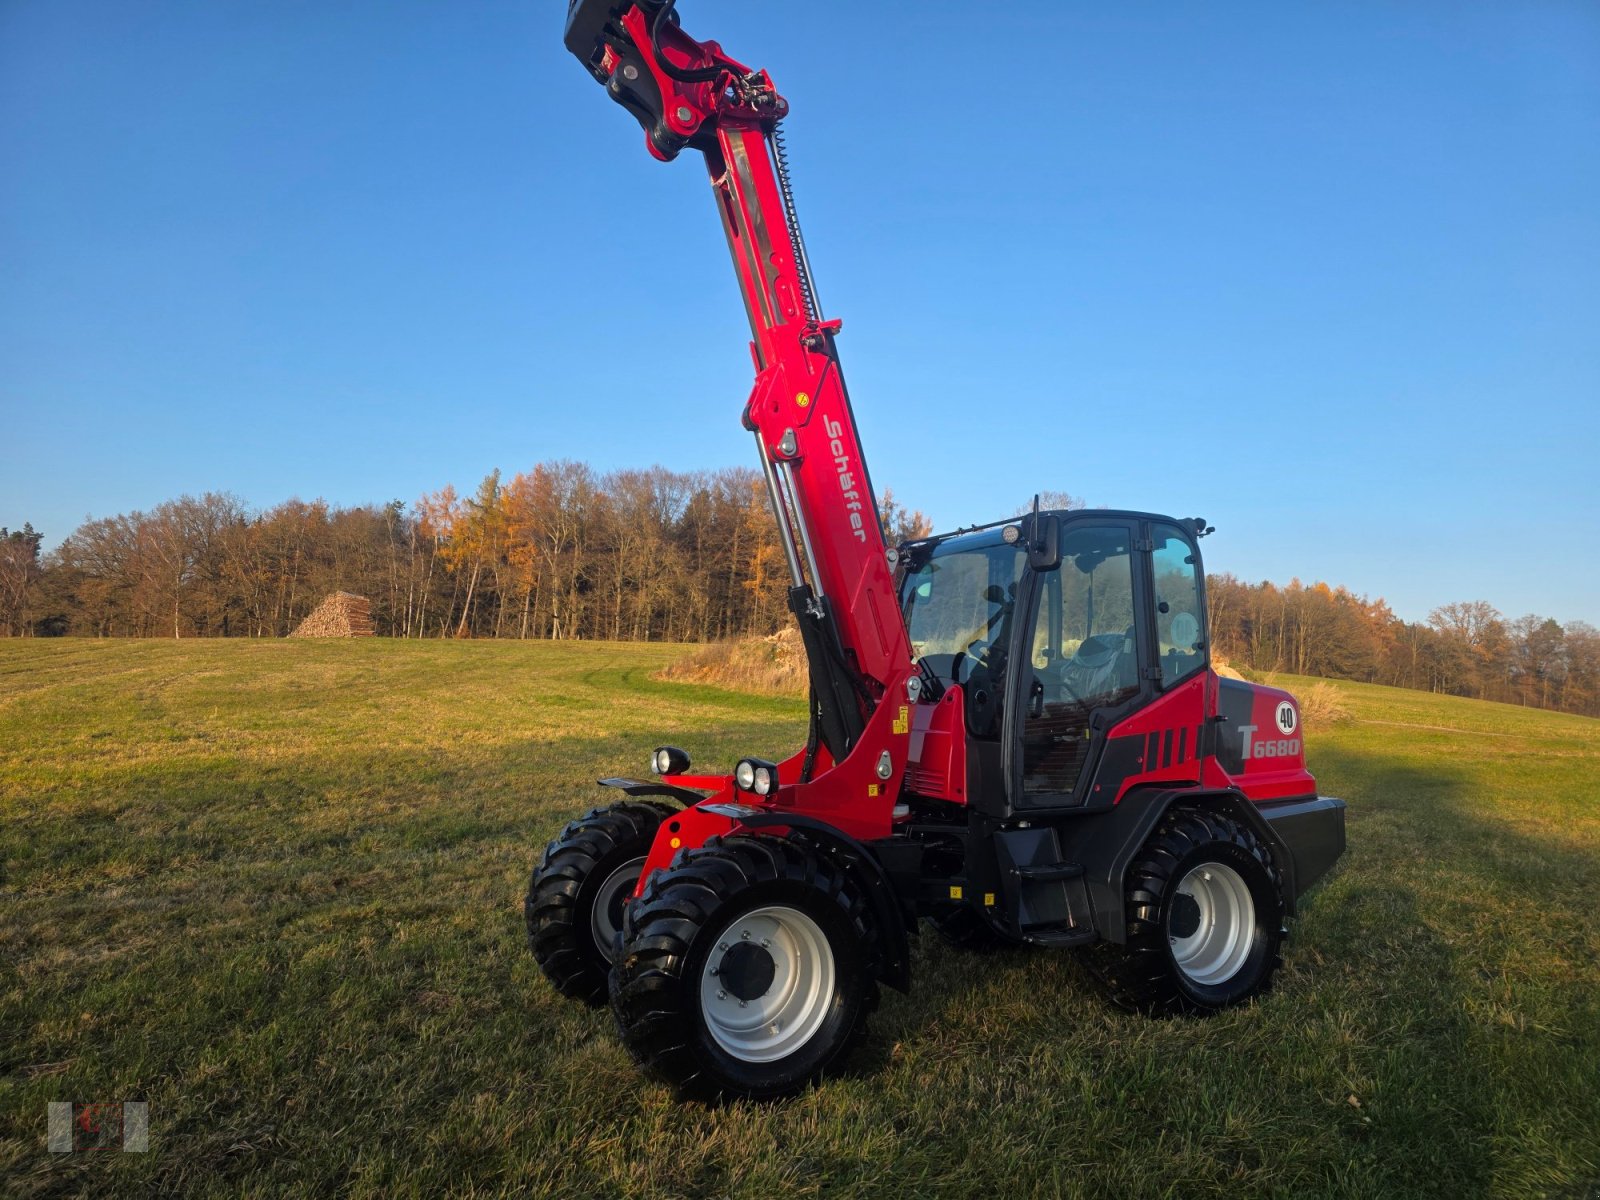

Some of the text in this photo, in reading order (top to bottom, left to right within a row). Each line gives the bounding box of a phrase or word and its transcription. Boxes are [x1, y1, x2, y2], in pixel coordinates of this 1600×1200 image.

[823, 414, 866, 543] Schäffer
[1280, 708, 1293, 728] 40
[1237, 725, 1300, 760] T6680
